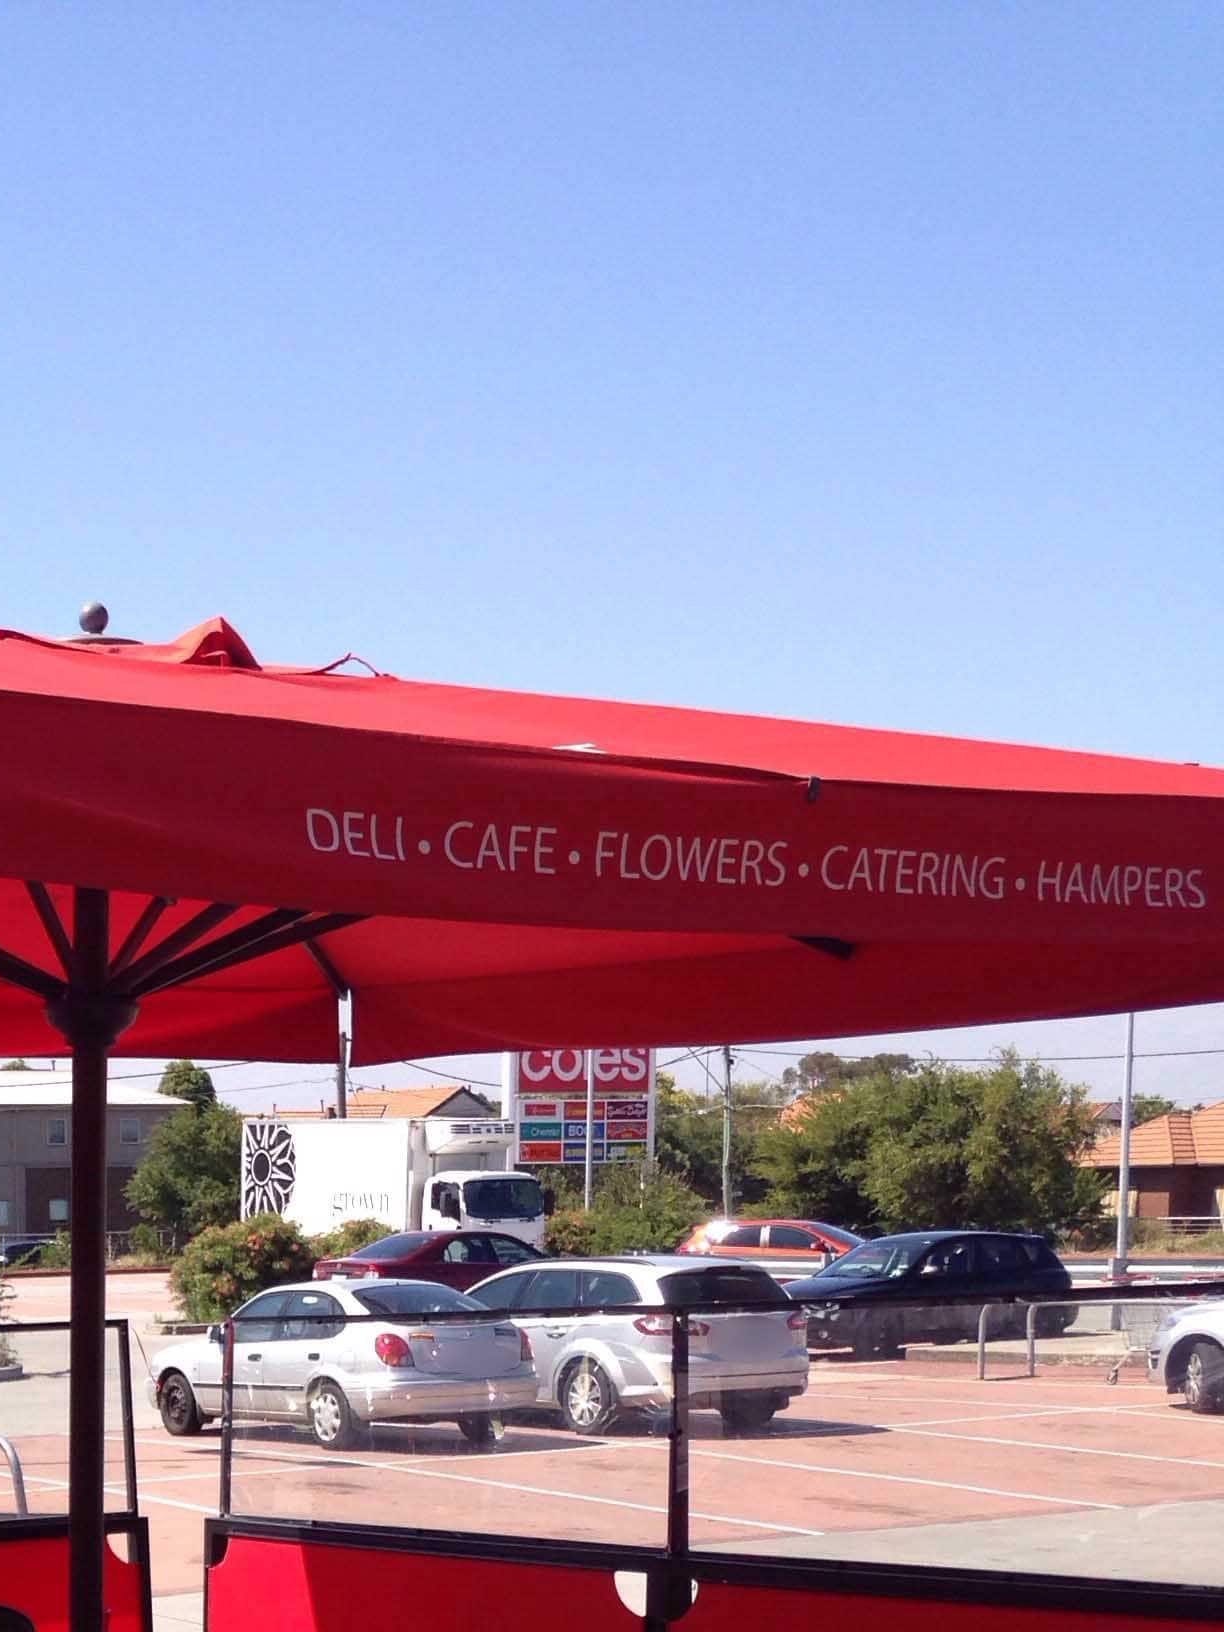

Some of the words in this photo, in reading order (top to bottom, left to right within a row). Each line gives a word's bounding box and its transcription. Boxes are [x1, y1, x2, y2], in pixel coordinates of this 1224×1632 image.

[305, 807, 406, 862] DELI
[443, 820, 558, 875] CAFE
[594, 830, 788, 887] FLOWERS
[819, 844, 1007, 901] CATERING
[1036, 859, 1207, 909] HAMPERS
